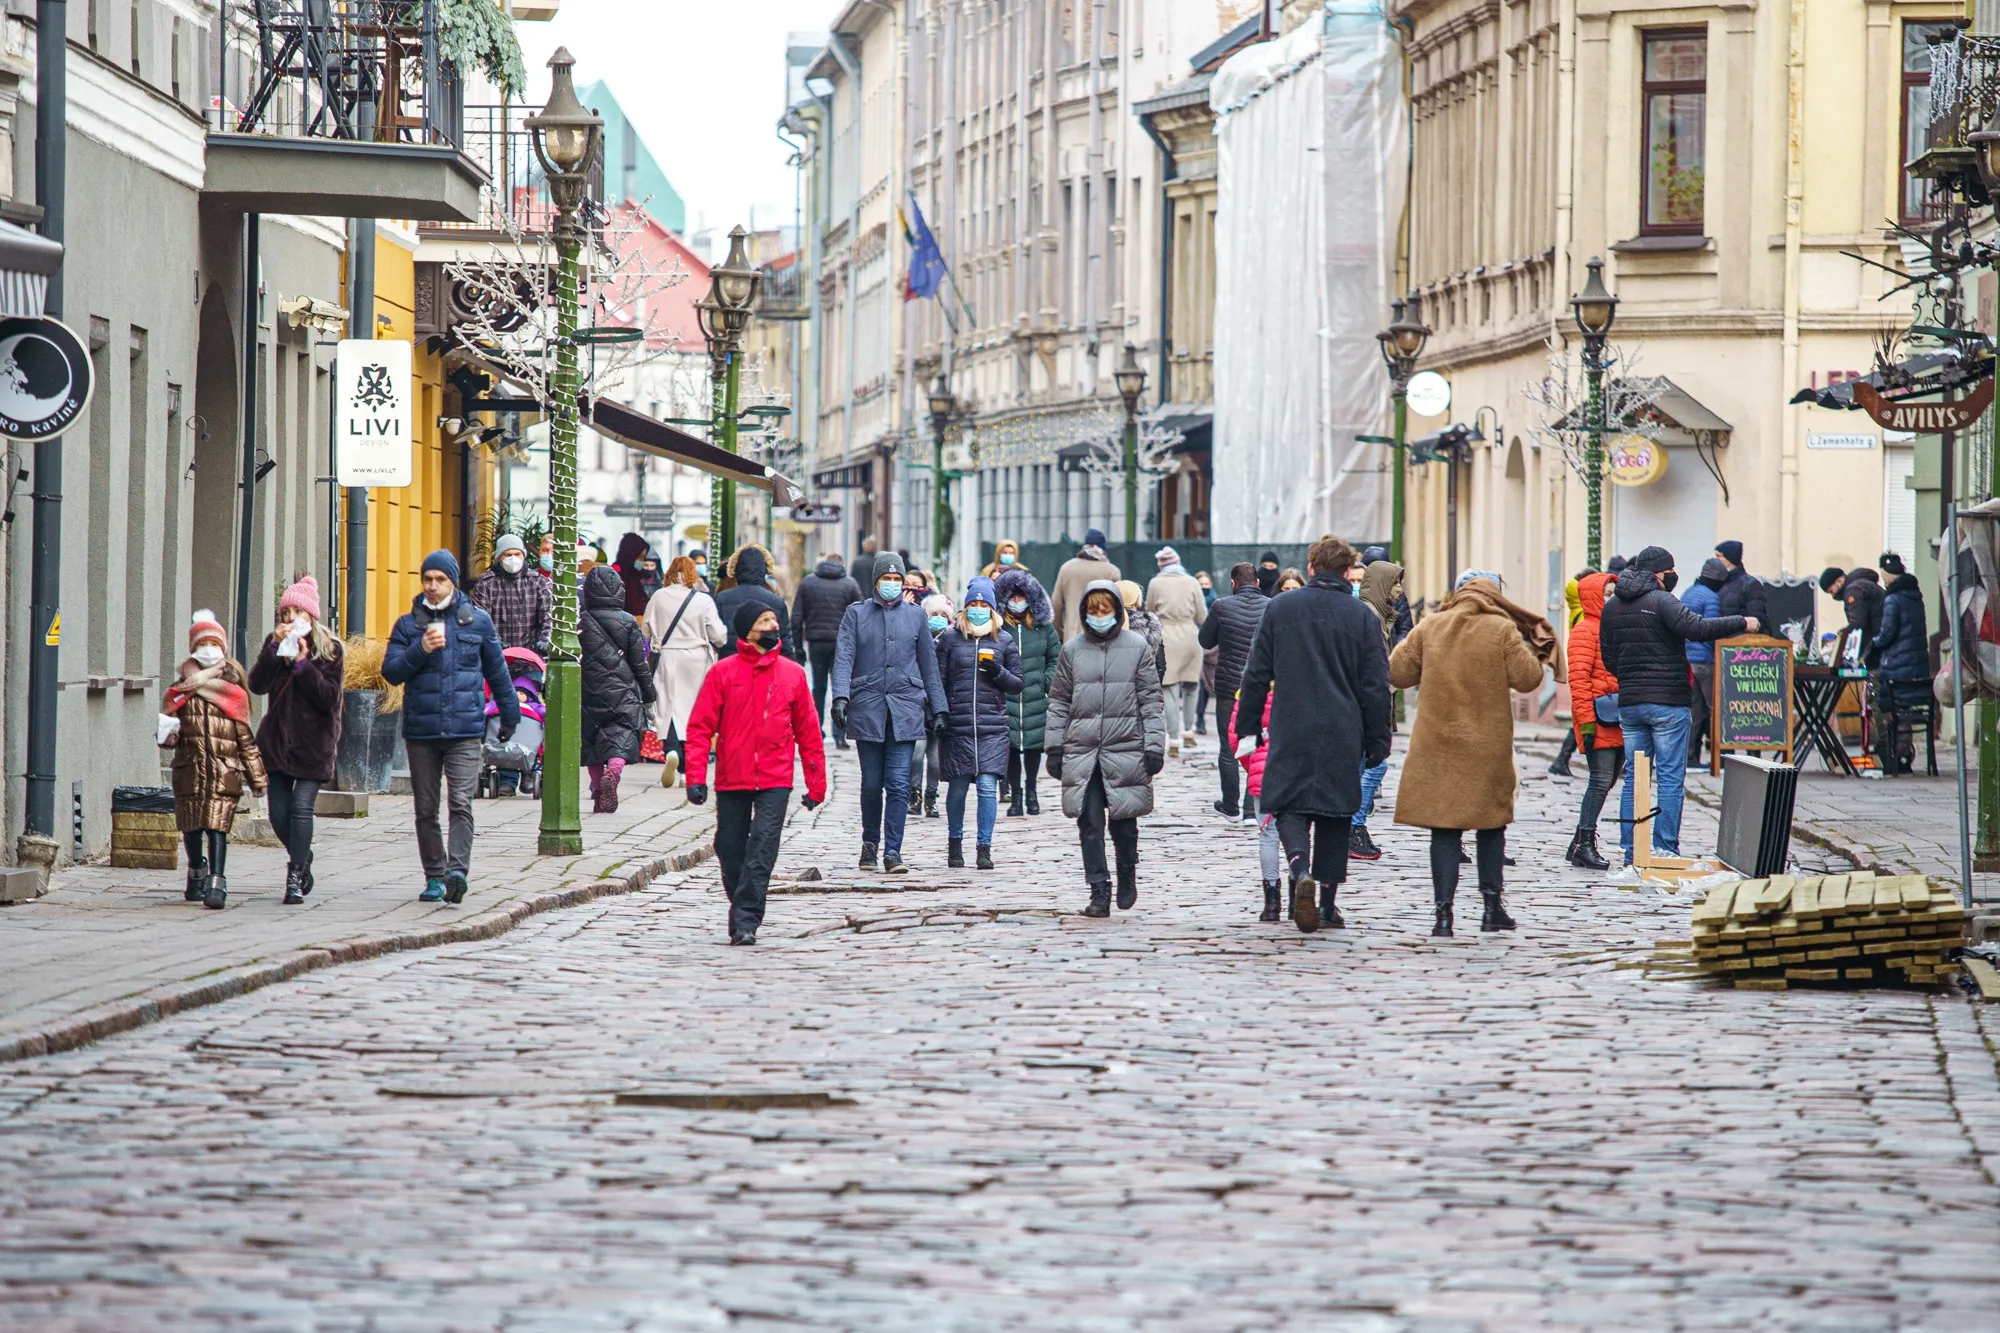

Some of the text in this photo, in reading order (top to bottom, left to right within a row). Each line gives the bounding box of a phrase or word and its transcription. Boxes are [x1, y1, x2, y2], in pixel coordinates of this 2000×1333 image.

[350, 418, 399, 435] LIVI
[1893, 407, 1958, 428] AVILYS
[1728, 698, 1783, 719] POPKORNAI
